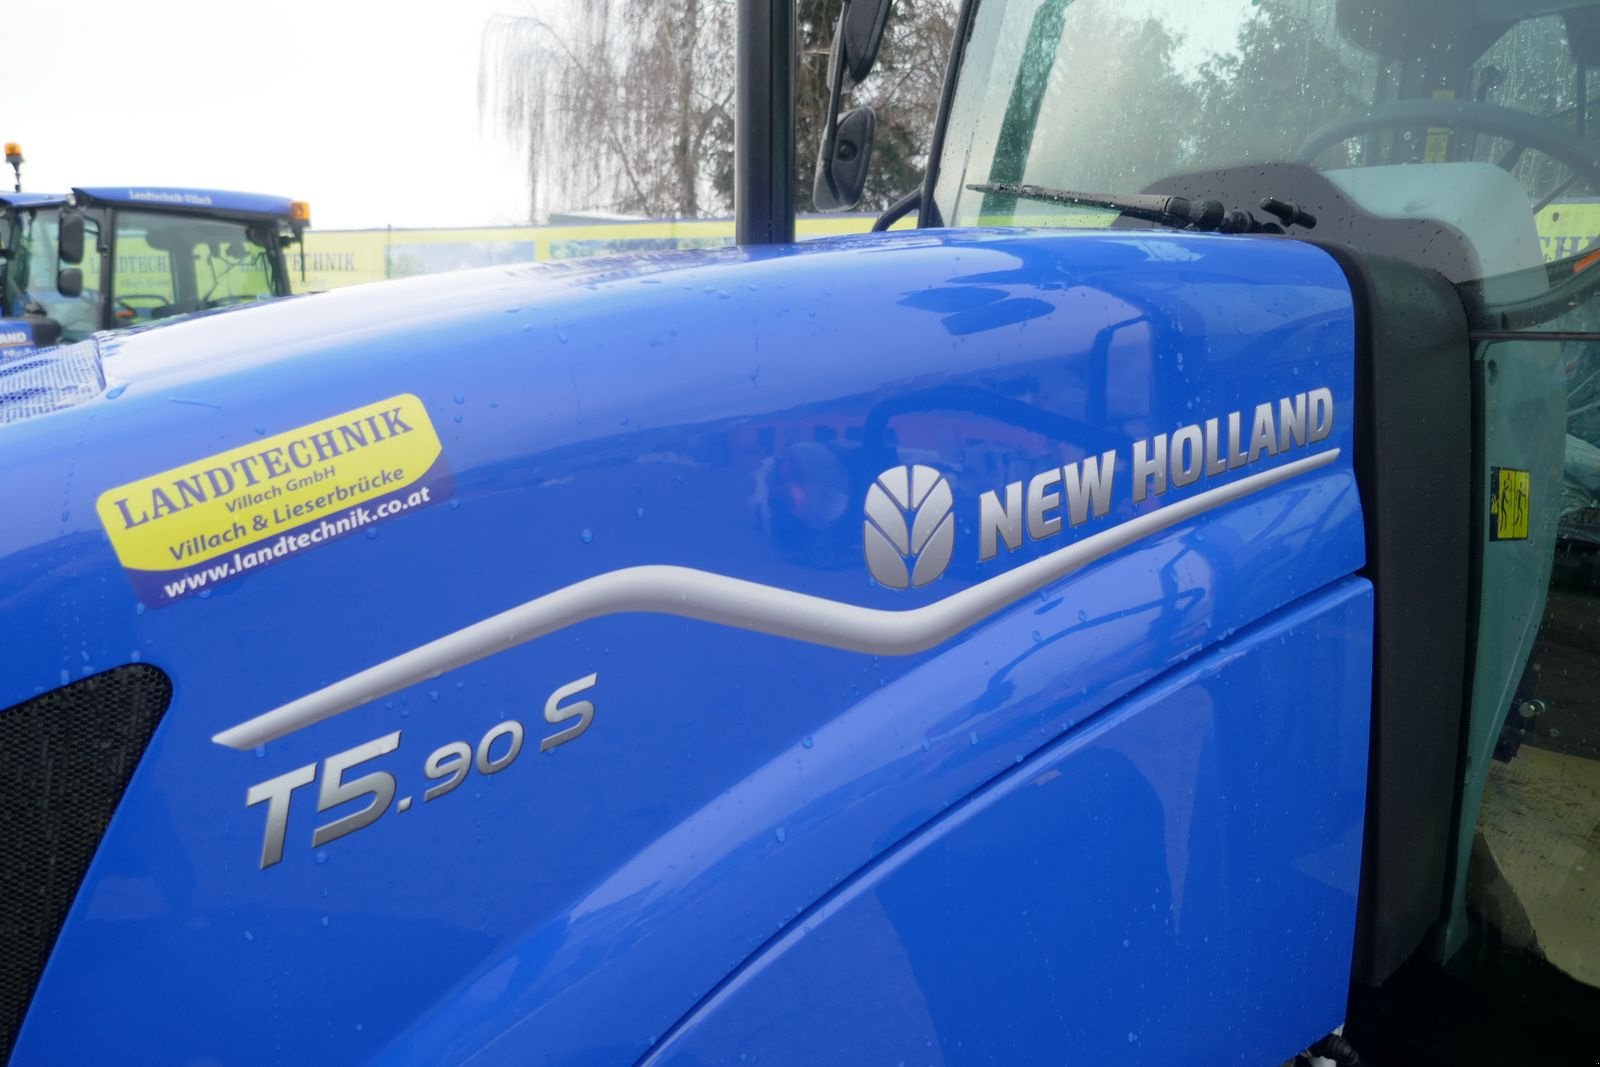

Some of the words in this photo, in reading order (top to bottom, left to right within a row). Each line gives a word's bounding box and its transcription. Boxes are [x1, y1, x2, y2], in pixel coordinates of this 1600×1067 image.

[113, 407, 414, 529] LANDTECHNIK
[169, 521, 248, 561] Villach
[252, 515, 269, 531] &
[273, 466, 405, 525] Lieserbrücke
[225, 487, 283, 514] Villach
[285, 465, 337, 492] GmbH
[979, 449, 1117, 562] NEW
[1132, 386, 1335, 503] HOLLAND
[164, 486, 431, 598] www.landtechnik.co.at
[540, 672, 598, 752] S
